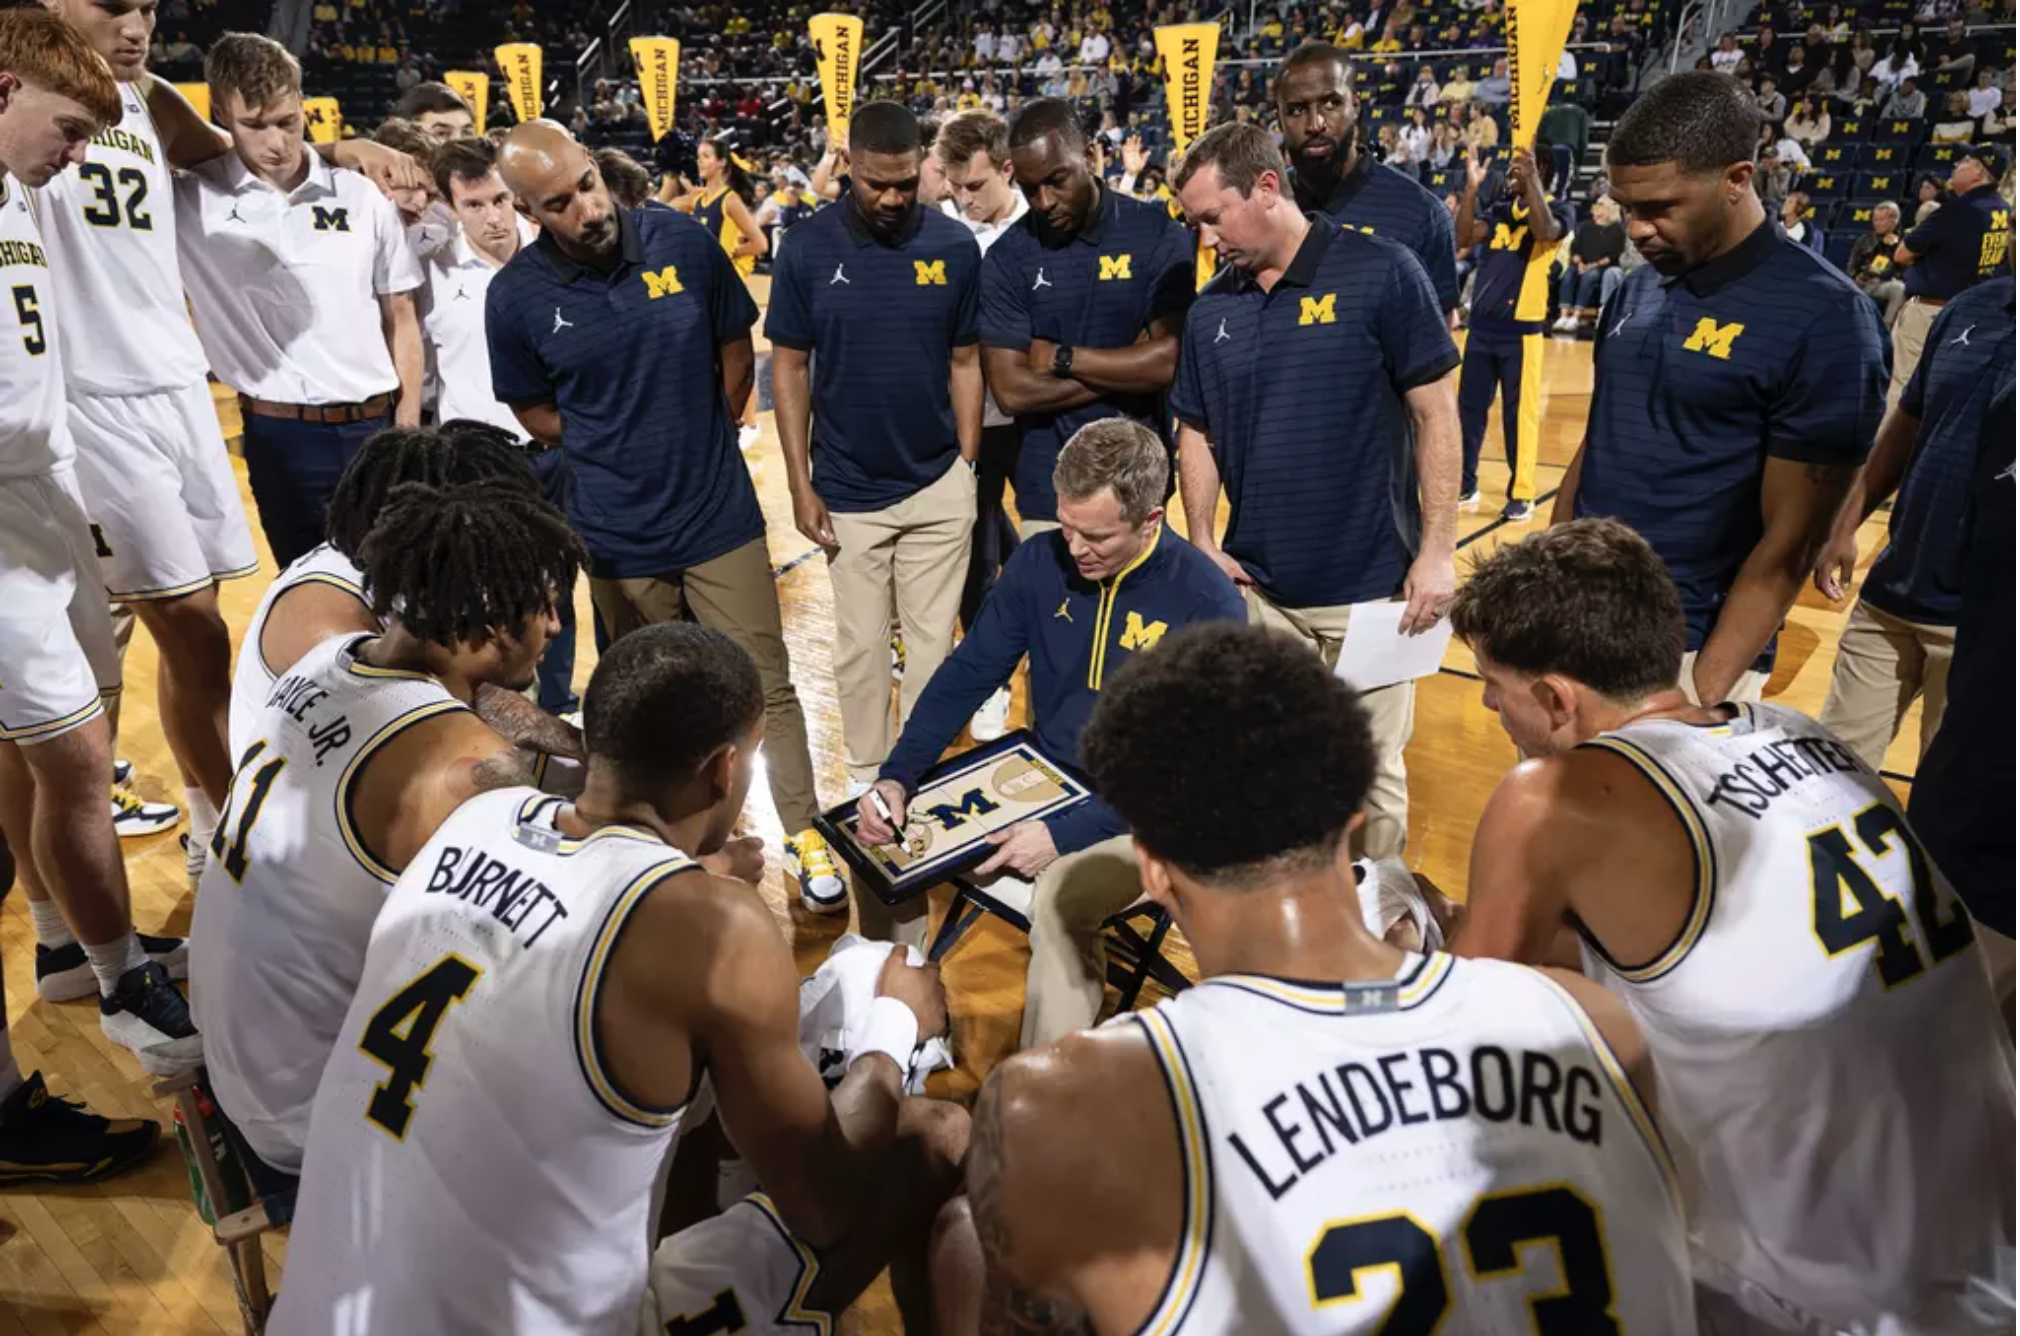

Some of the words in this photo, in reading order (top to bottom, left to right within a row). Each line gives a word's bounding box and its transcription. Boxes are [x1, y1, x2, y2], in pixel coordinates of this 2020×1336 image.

[654, 48, 672, 132] MICHIGAN
[835, 24, 849, 119] MICHIGAN
[1183, 38, 1200, 149] MICHIGAN
[1507, 6, 1520, 131] MICHIGAN
[88, 126, 155, 165] HIGAN
[78, 162, 152, 231] 32
[312, 205, 351, 232] M
[1990, 210, 2009, 230] M
[1489, 222, 1529, 252] M
[642, 266, 684, 299] M
[914, 260, 947, 285] M
[1100, 254, 1132, 280] M
[11, 284, 46, 358] 5
[1300, 294, 1337, 326] M
[1683, 316, 1744, 359] M
[1119, 610, 1168, 651] M
[308, 714, 352, 768] JR.
[926, 788, 1001, 832] M
[425, 846, 569, 951] BURNETT
[1805, 800, 1975, 992] 42
[358, 951, 485, 1144] 4
[1227, 1045, 1600, 1201] LENDEBORG
[1303, 1180, 1625, 1336] 23
